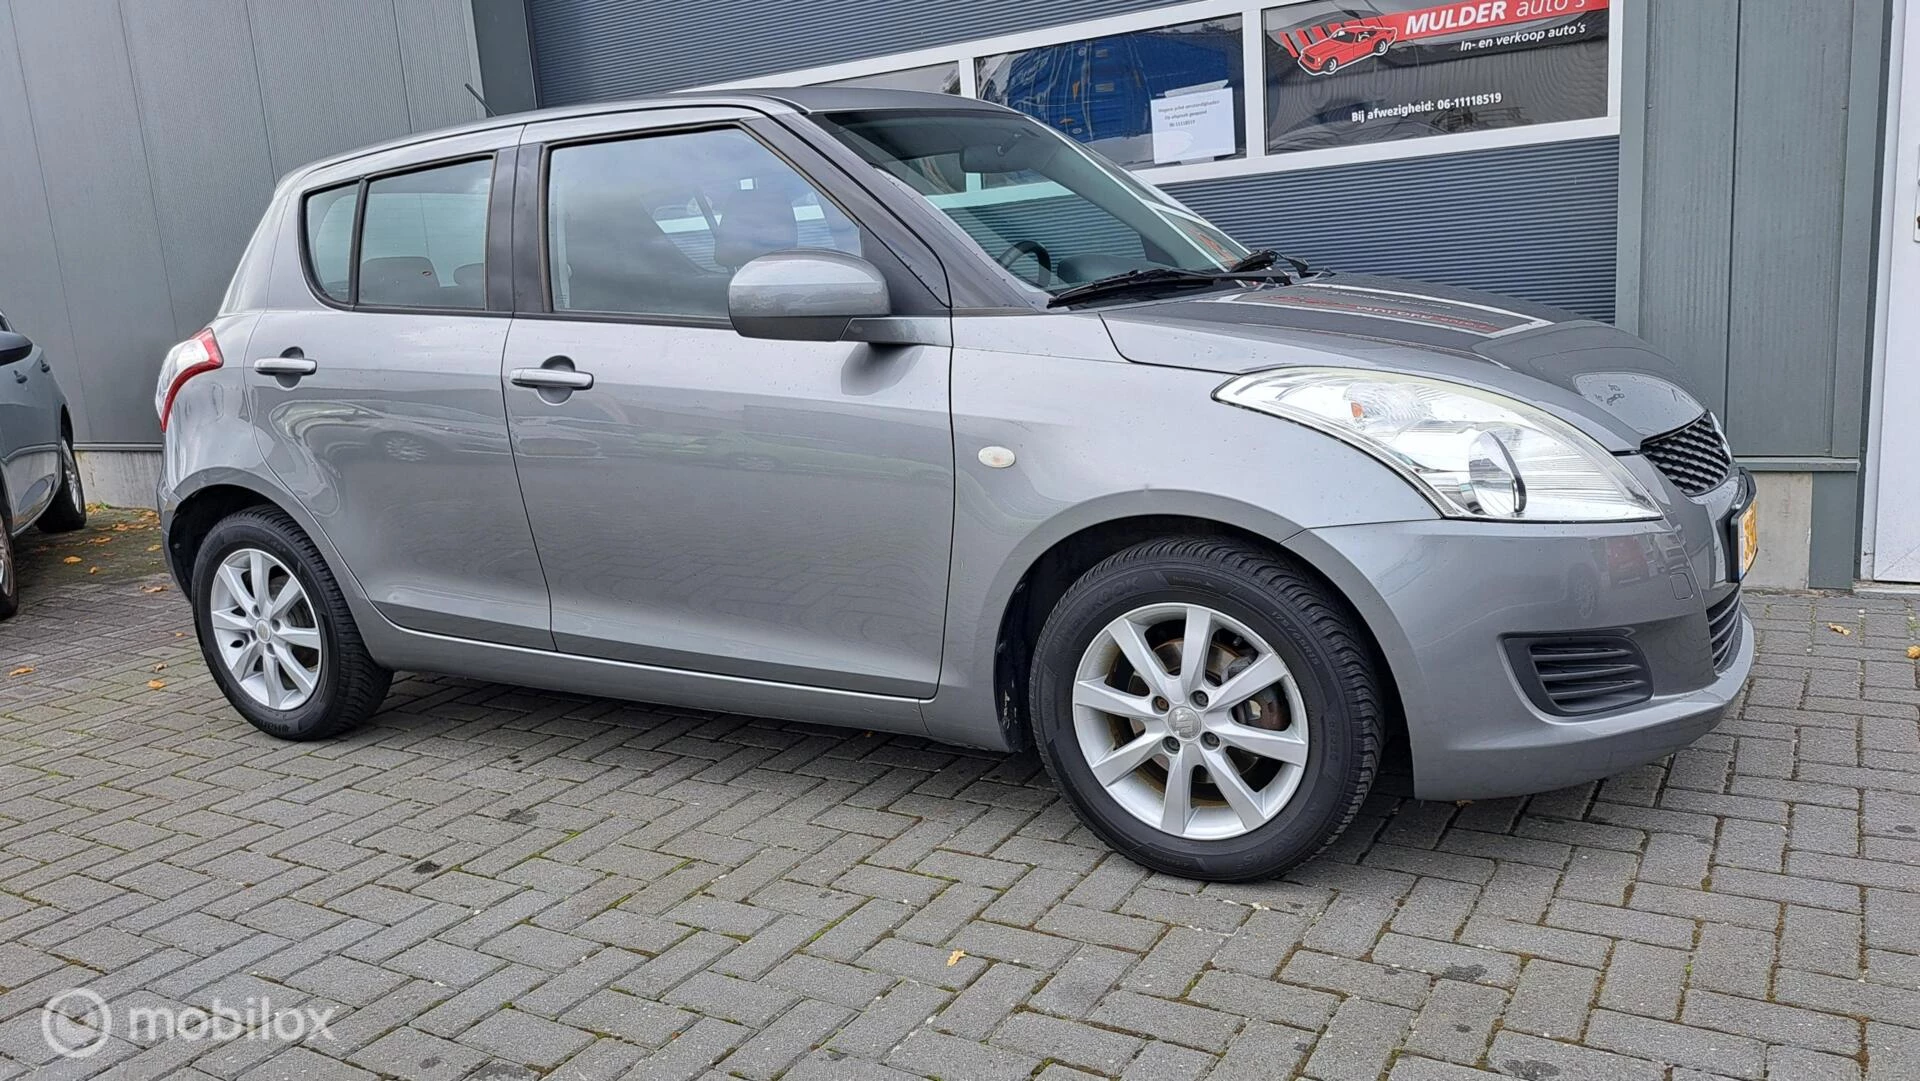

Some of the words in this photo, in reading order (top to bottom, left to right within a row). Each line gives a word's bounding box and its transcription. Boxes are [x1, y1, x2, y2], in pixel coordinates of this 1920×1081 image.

[1405, 1, 1507, 35] MULDER
[1460, 40, 1476, 51] In-
[1478, 38, 1493, 49] en
[1496, 31, 1545, 45] verkoop
[1548, 22, 1586, 38] auto's
[1351, 110, 1365, 123] Bij
[1367, 101, 1434, 119] afwezigheid:
[1437, 92, 1502, 109] 06-11118519
